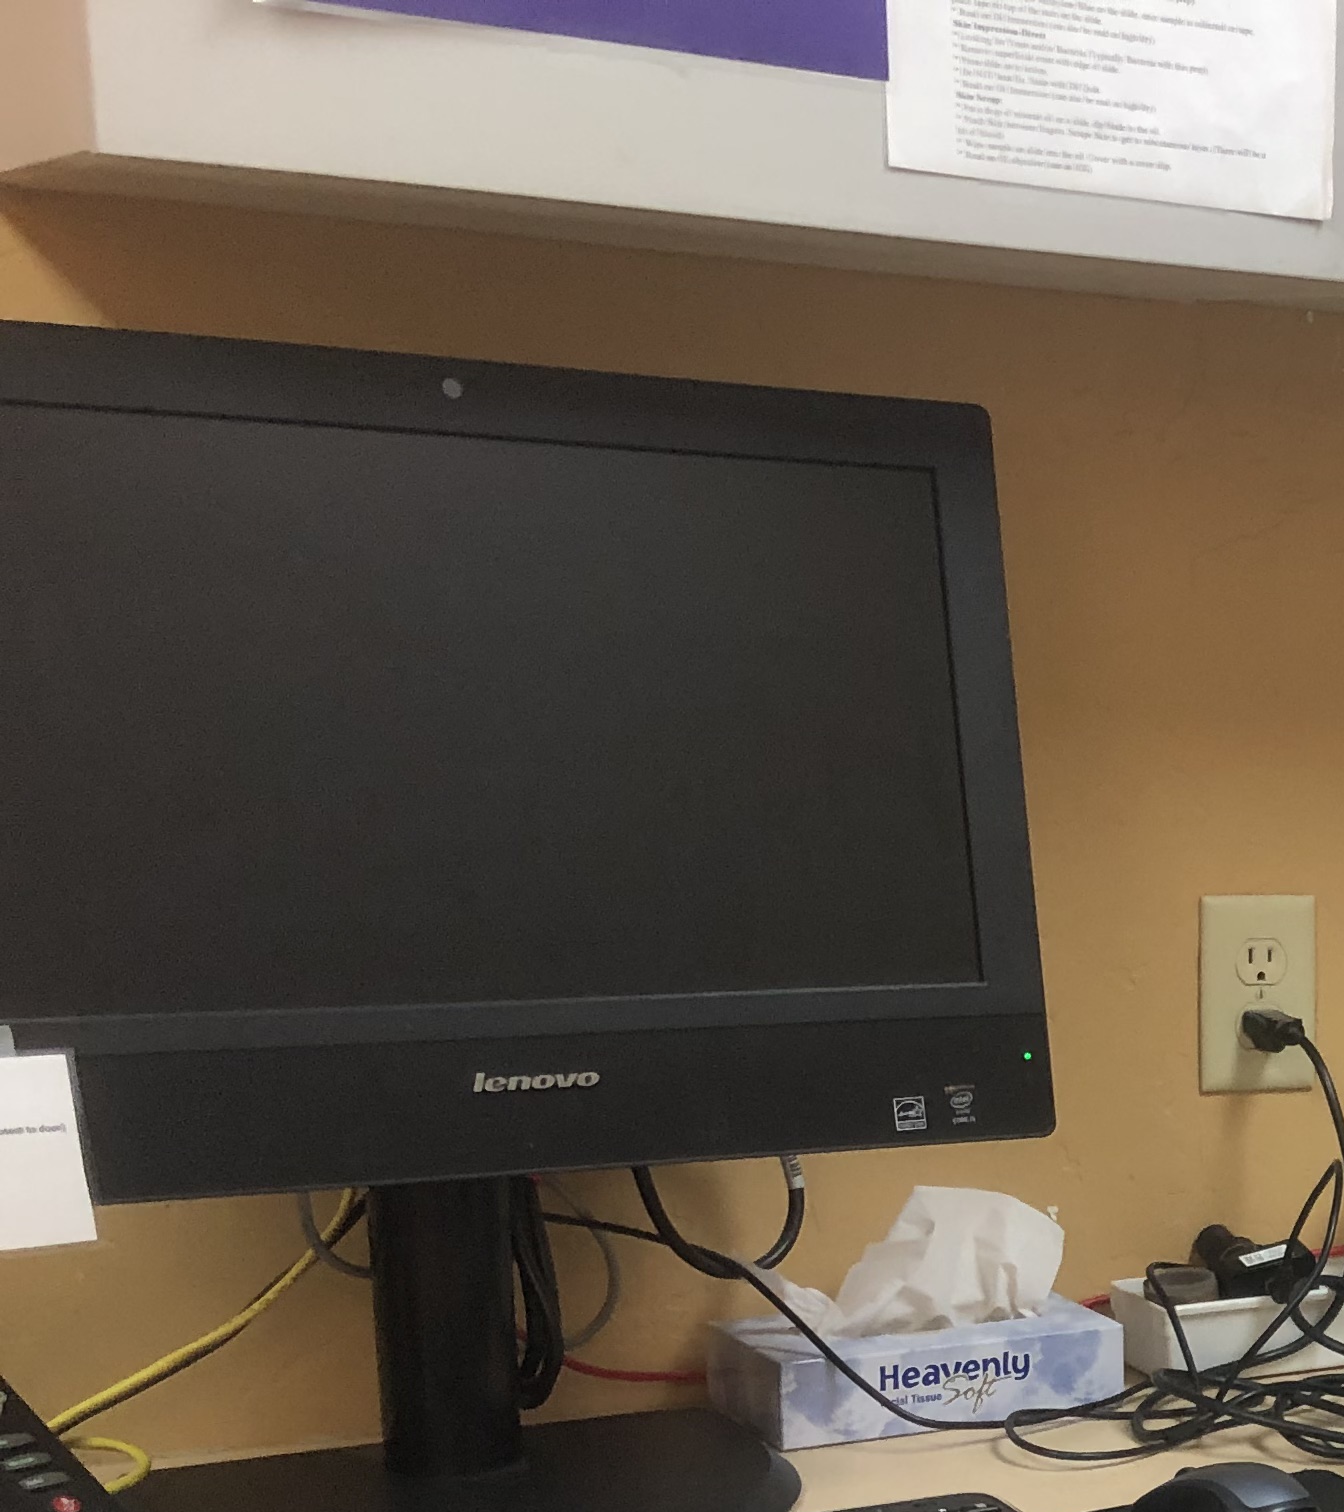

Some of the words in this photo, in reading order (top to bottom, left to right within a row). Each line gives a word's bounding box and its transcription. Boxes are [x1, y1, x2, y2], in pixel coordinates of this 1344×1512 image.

[472, 1068, 601, 1094] lenovo
[879, 1351, 1031, 1393] Heavenly
[914, 1391, 942, 1405] Tissue
[941, 1374, 1012, 1416] Soft
